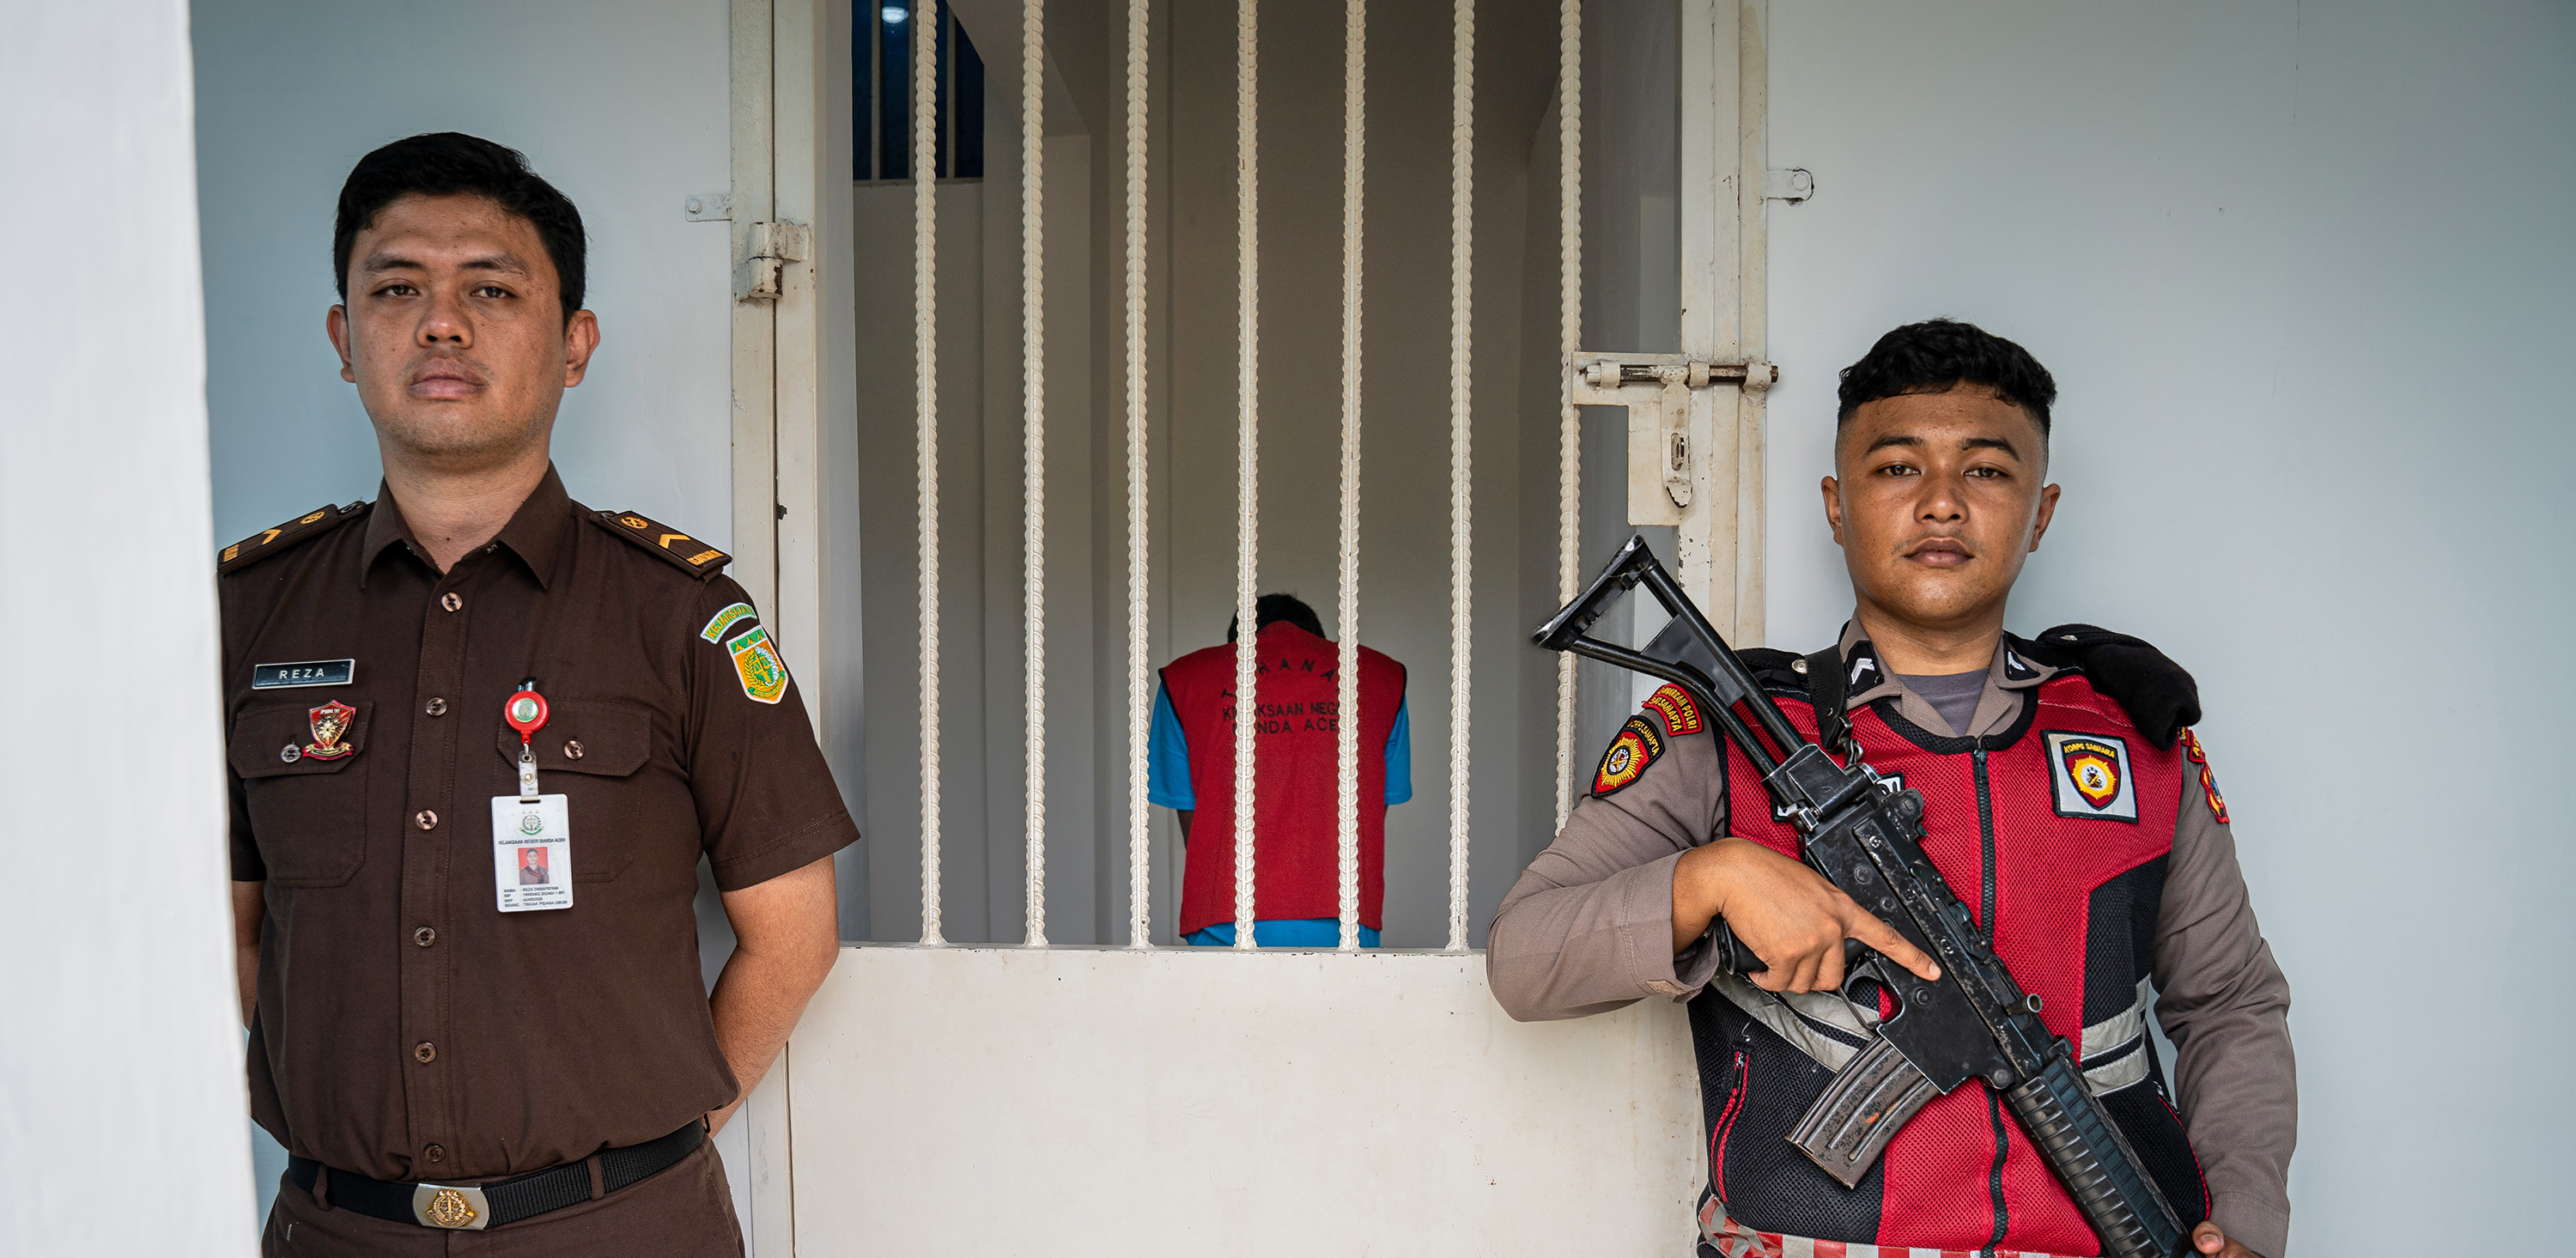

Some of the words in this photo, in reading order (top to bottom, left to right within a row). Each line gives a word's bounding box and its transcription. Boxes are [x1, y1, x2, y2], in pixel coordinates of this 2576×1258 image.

[705, 605, 748, 640] KEJAKSAAN
[279, 668, 325, 679] REZA
[1221, 658, 1339, 697] THANA
[1303, 718, 1338, 732] ACE
[1681, 704, 1698, 729] POLRI
[1641, 725, 1660, 757] SAMAPTA
[2063, 743, 2084, 753] KORPS
[2085, 743, 2115, 758] SABHARA
